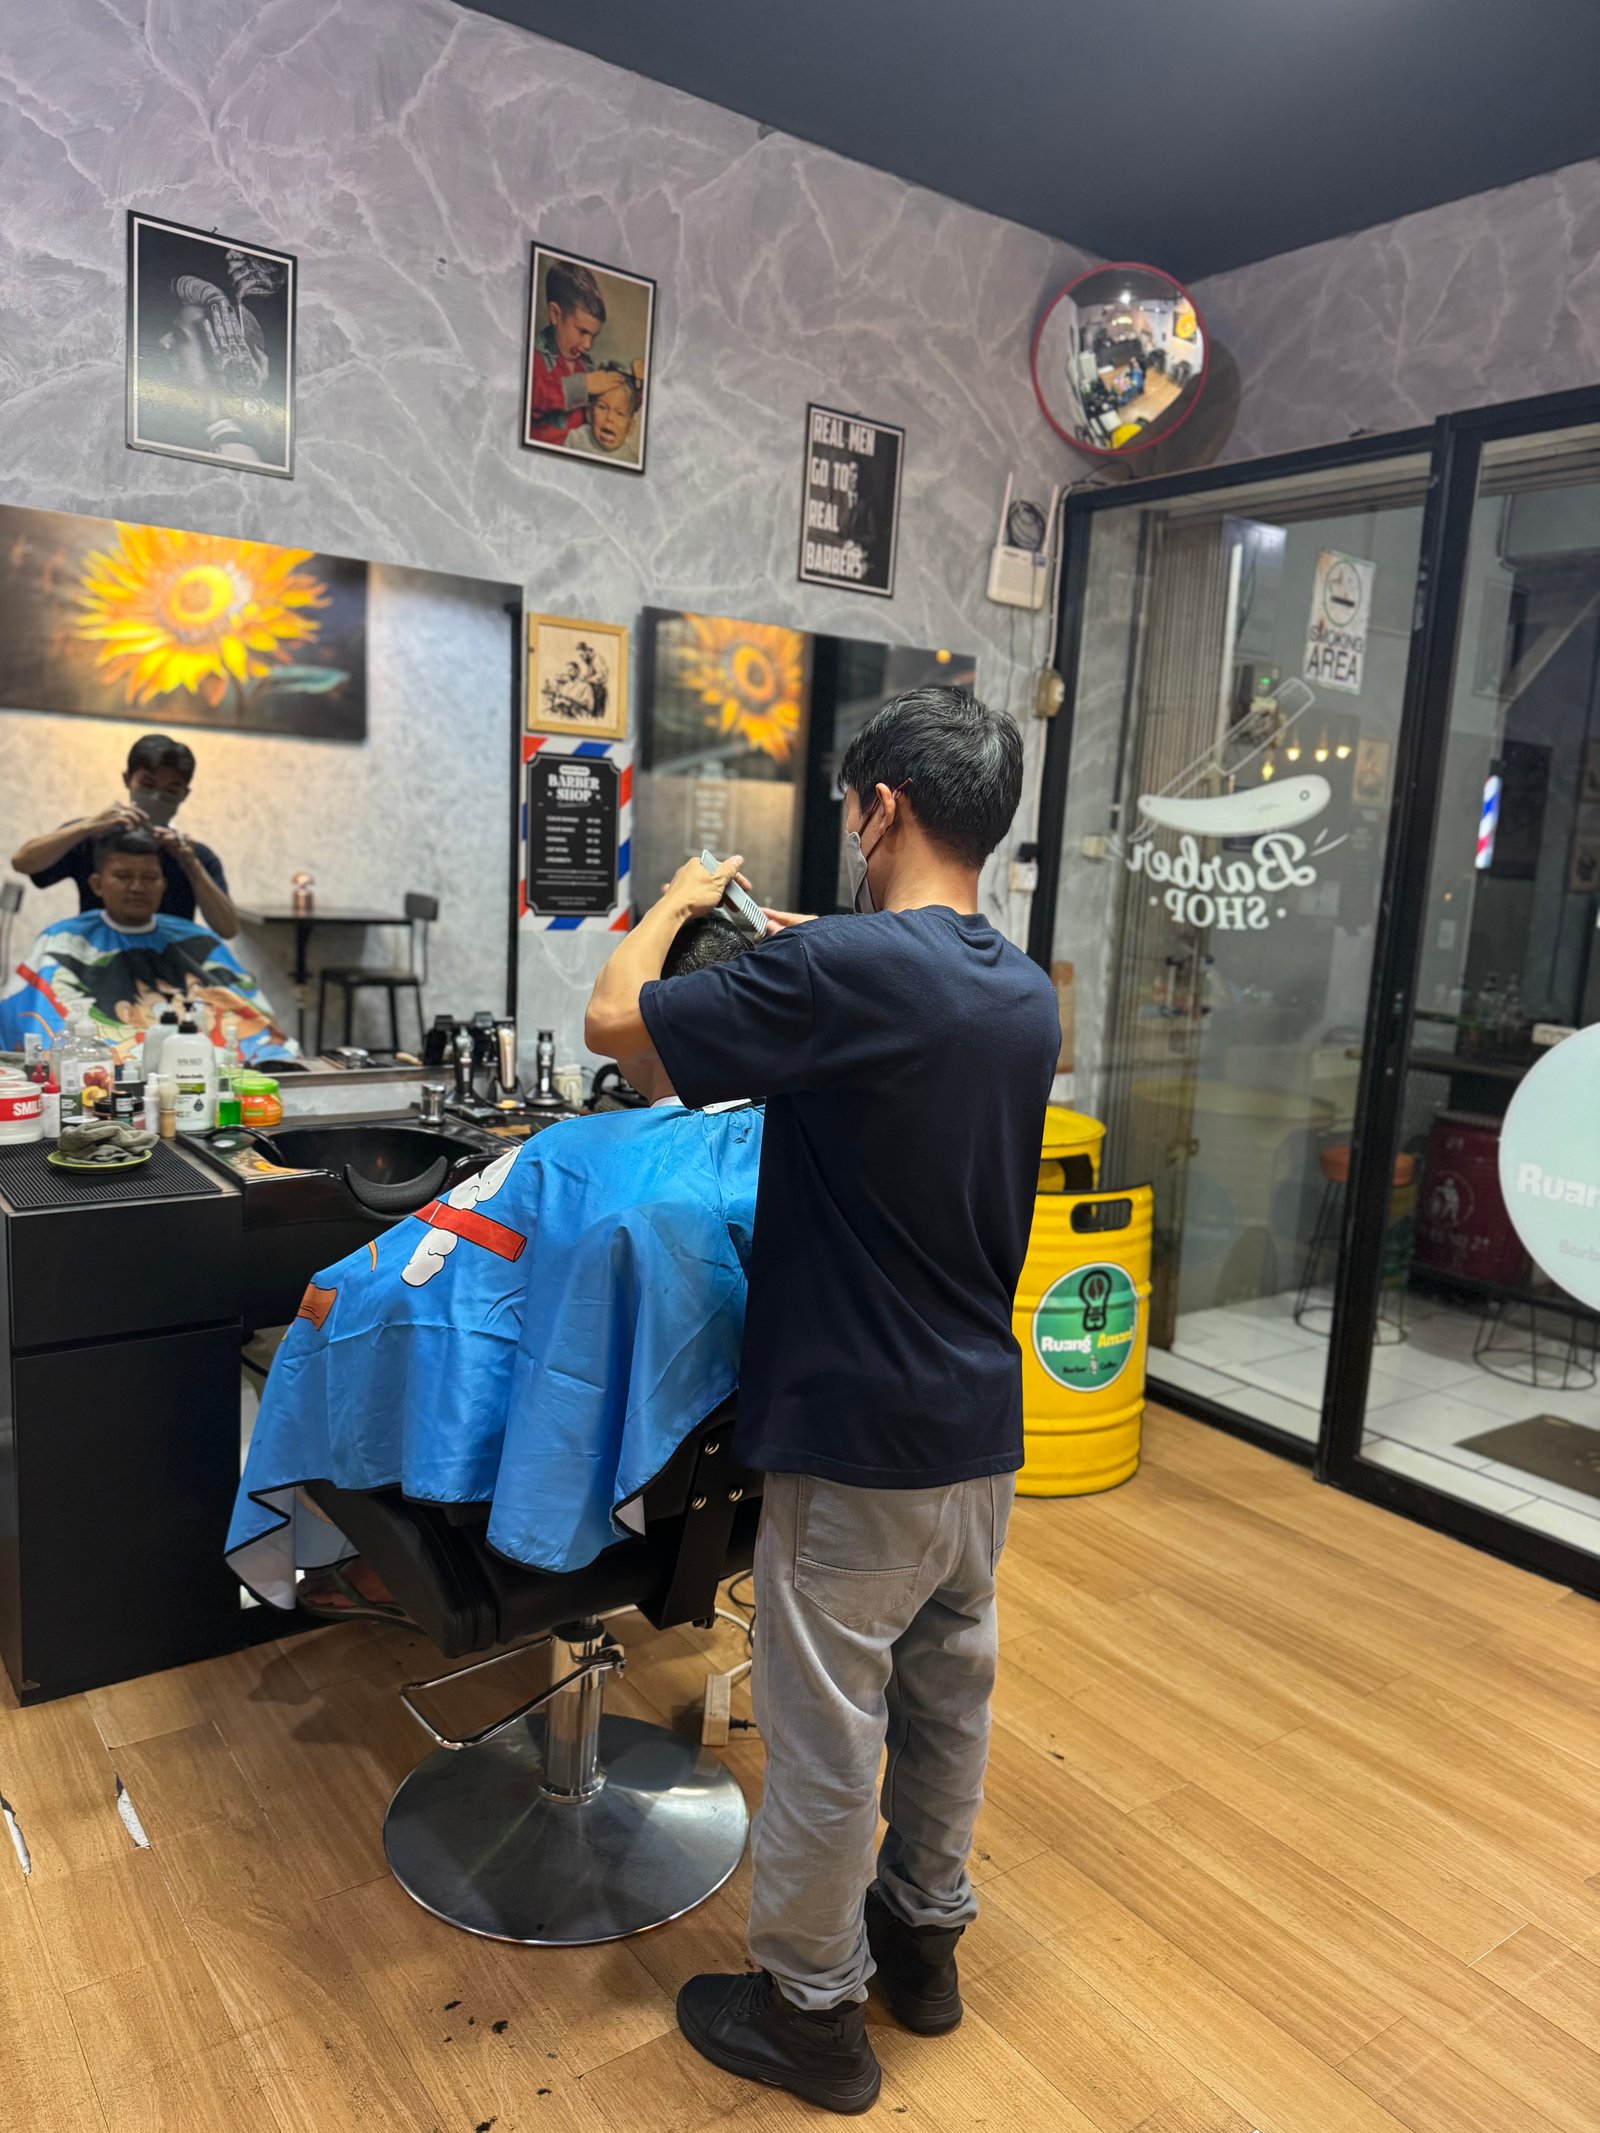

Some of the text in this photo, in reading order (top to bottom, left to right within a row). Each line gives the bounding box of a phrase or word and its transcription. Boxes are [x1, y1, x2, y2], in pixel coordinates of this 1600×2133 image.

[813, 414, 876, 457] REAL MEN
[811, 456, 850, 492] GO TO
[808, 499, 840, 534] REAL
[1310, 624, 1364, 654] SMOKING
[1307, 644, 1358, 684] AREA
[548, 773, 600, 791] BARBER
[556, 787, 592, 802] SHOP
[1040, 1333, 1092, 1354] Ruang
